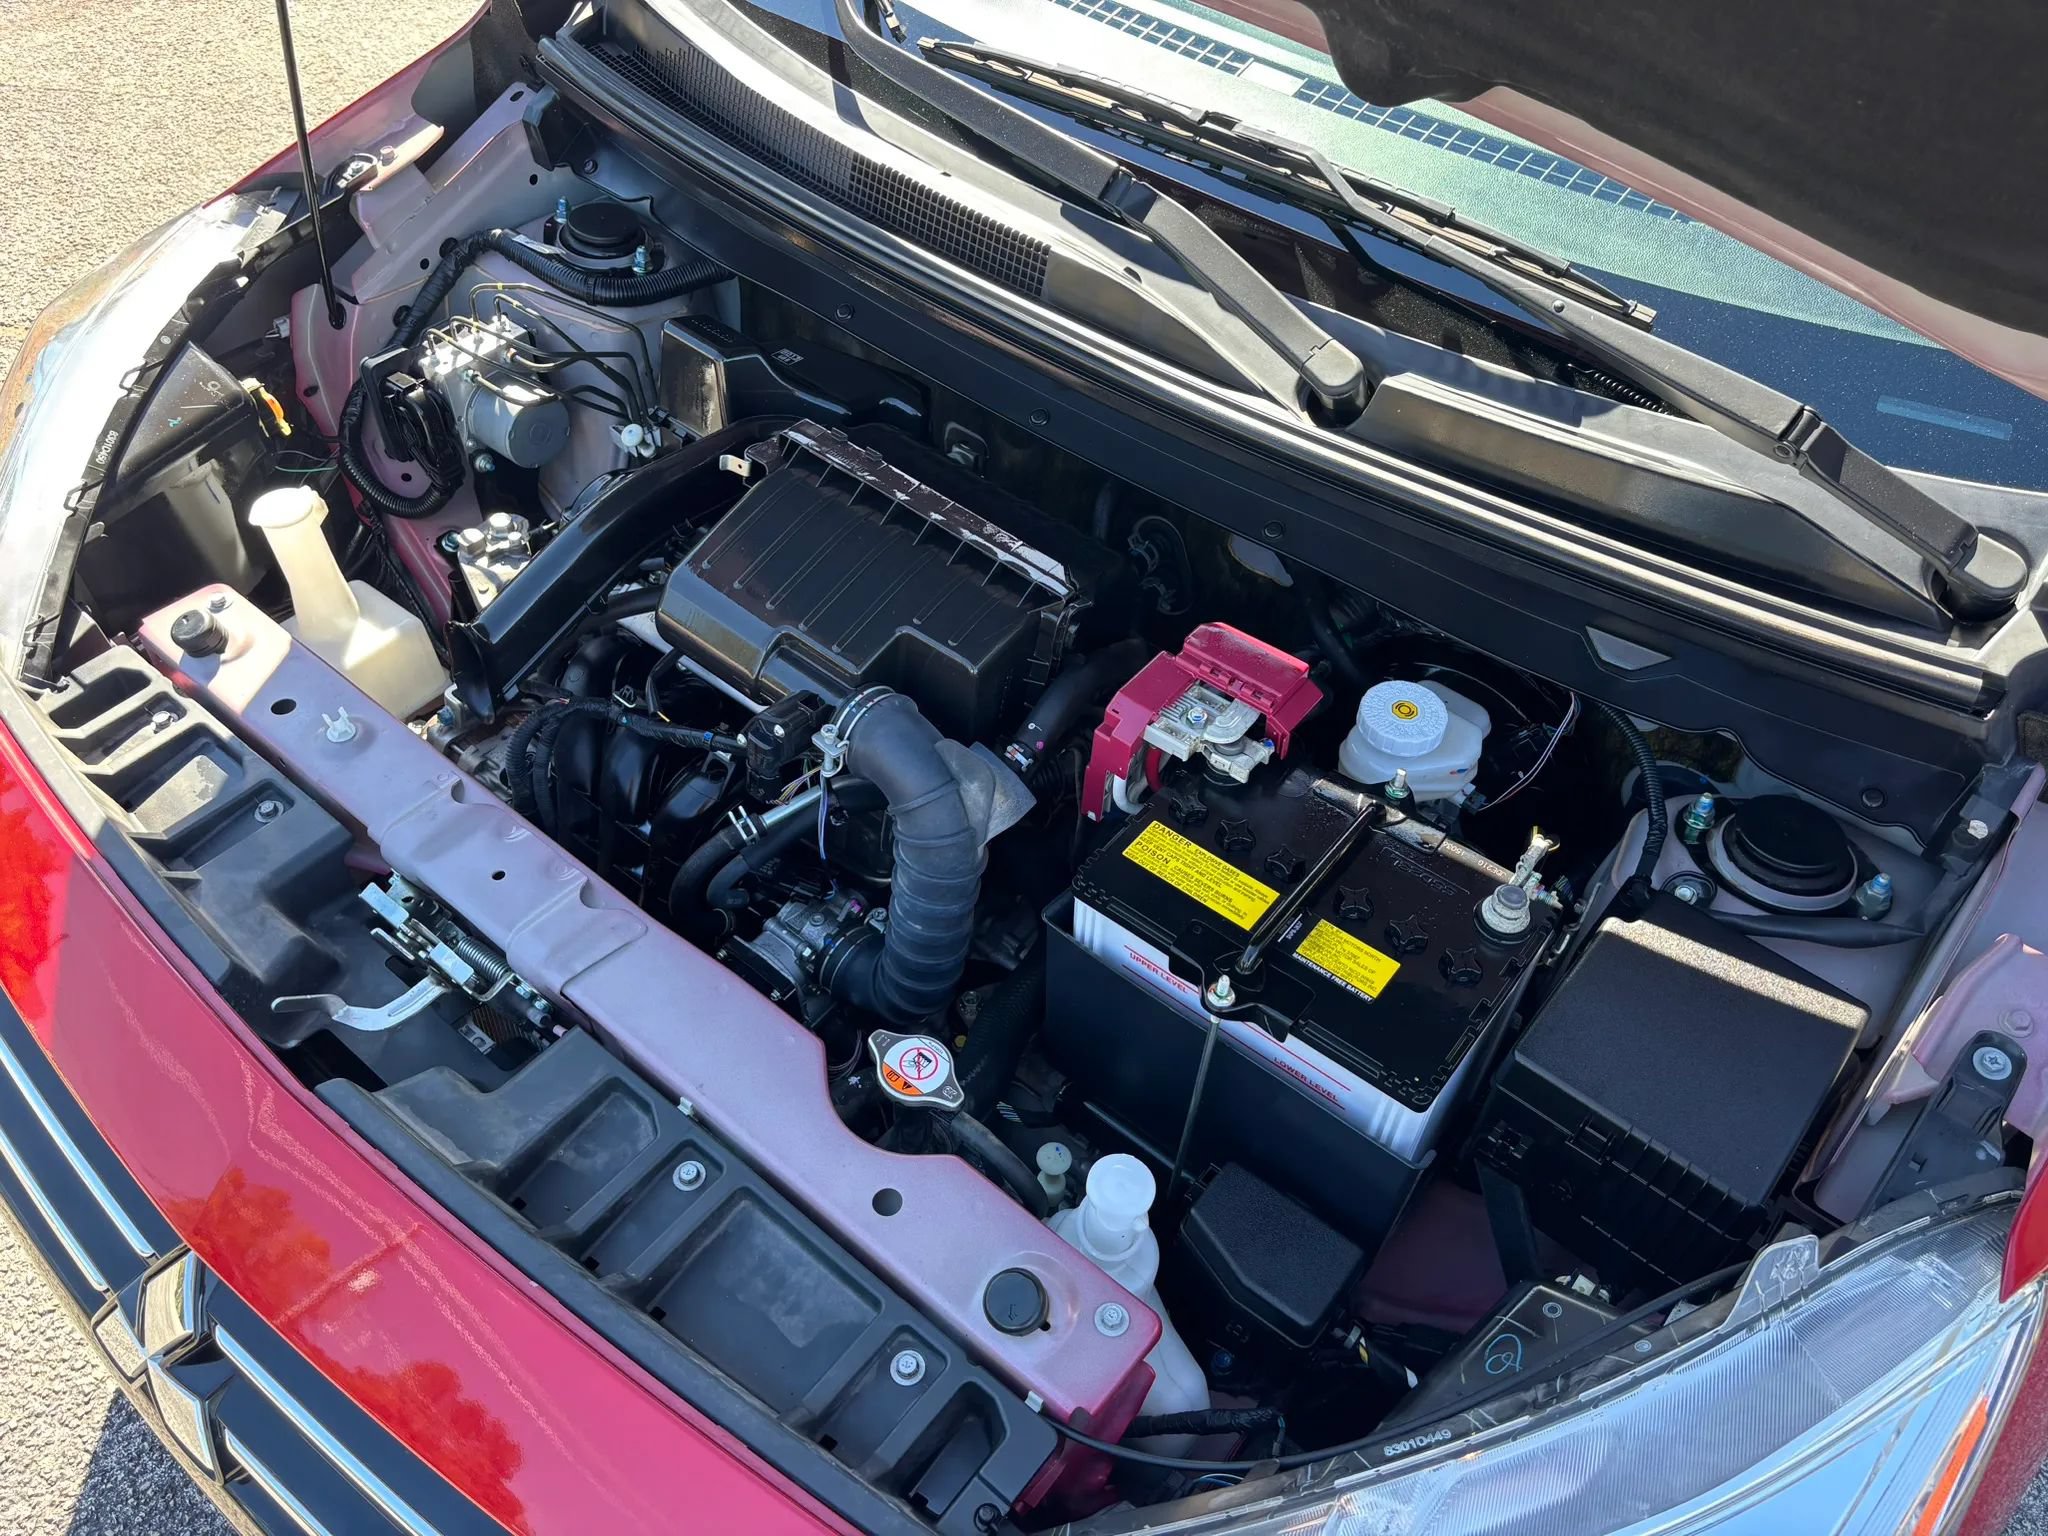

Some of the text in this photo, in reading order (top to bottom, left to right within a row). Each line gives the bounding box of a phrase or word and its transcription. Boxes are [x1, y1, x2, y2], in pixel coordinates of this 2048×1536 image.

[95, 430, 119, 465] 8301D450
[1152, 822, 1192, 848] DANGER
[1134, 840, 1171, 865] POISON
[1137, 858, 1149, 867] OUT
[1478, 858, 1507, 878] JDE210
[1165, 851, 1180, 862] CAPS
[1193, 869, 1206, 878] AND
[1205, 876, 1223, 888] LEVEL
[1129, 952, 1188, 994] UPPER LEVEL
[1292, 952, 1332, 978] MAINTENANCE
[1330, 974, 1347, 988] FREE
[1345, 984, 1373, 1002] BATTERY
[1273, 1056, 1338, 1102] LOWER LEVEL
[1384, 1429, 1452, 1456] 8301D449
